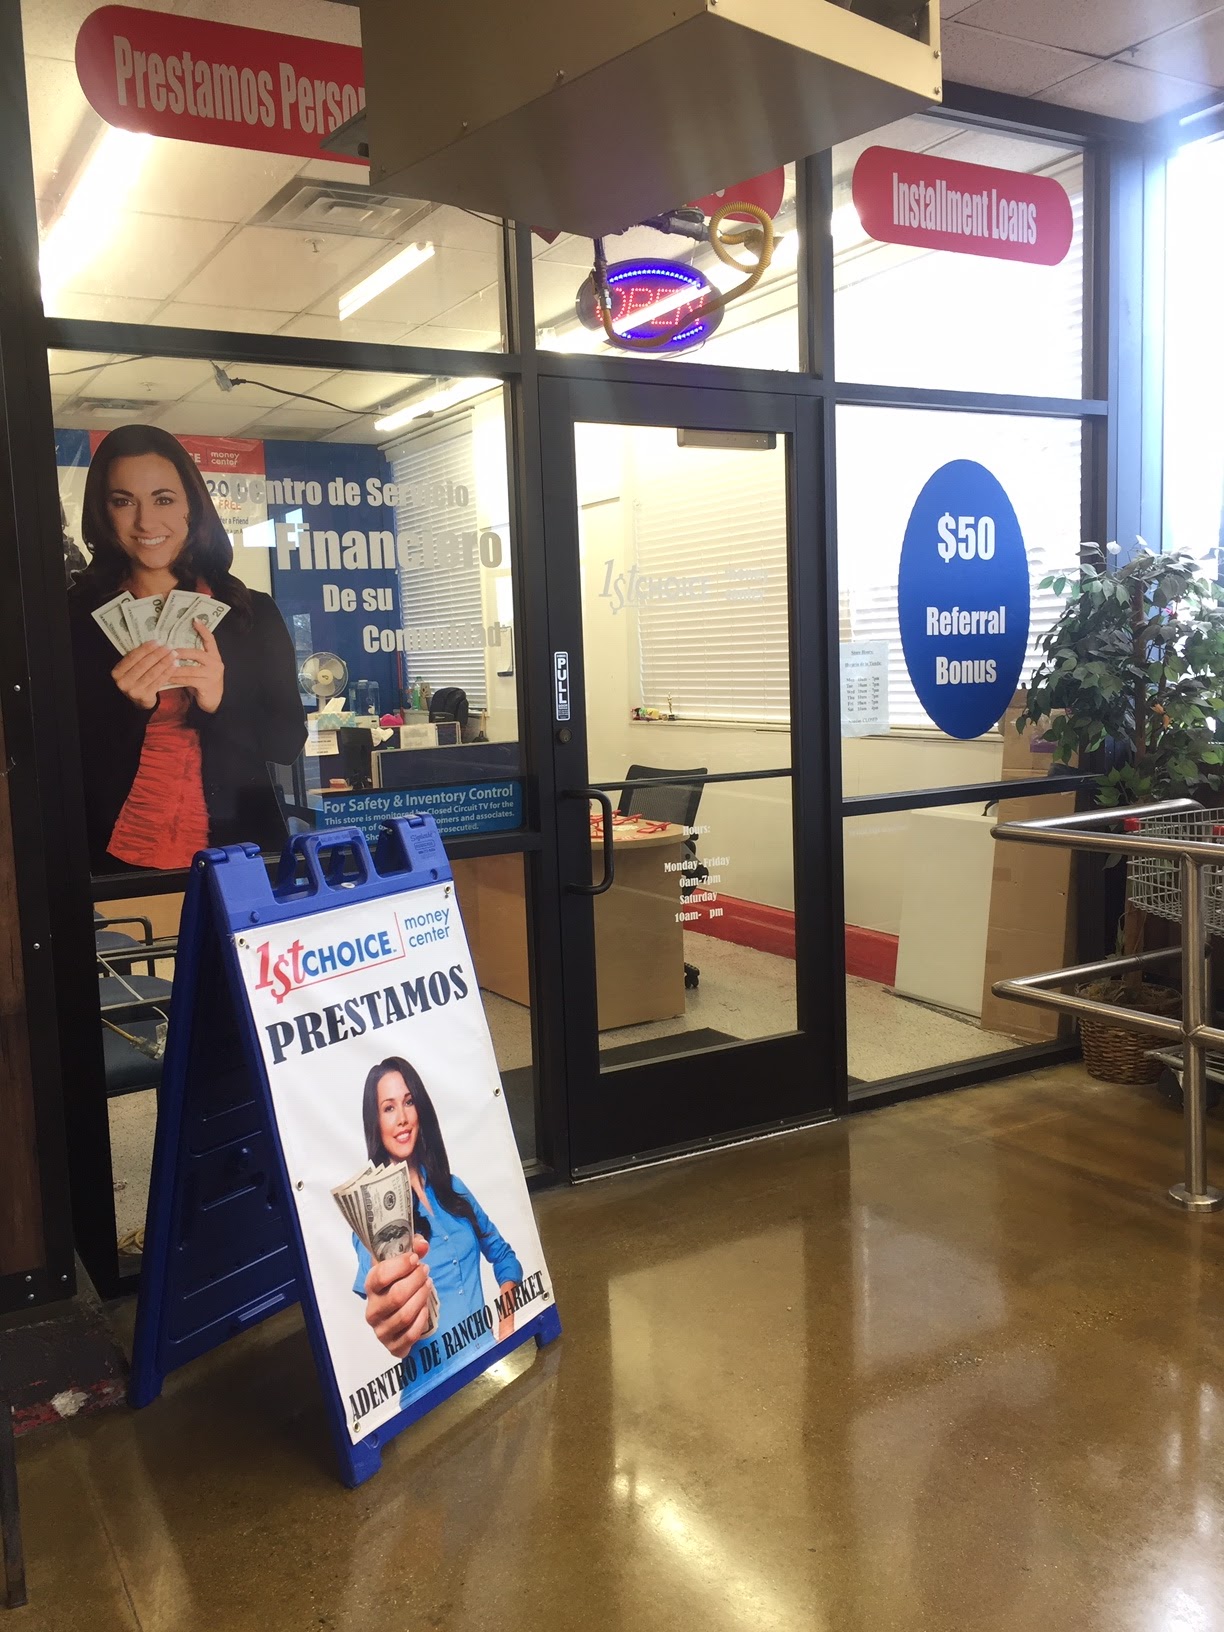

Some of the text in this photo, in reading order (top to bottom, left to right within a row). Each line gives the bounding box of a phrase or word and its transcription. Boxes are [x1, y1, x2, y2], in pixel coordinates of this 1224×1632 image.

[113, 35, 366, 134] Prestamos Perso
[893, 172, 1036, 245] Installment Loans
[211, 450, 240, 460] money
[230, 476, 323, 506] Centro
[327, 477, 361, 507] de
[275, 522, 503, 570] Financiero
[937, 512, 996, 564] $50
[322, 584, 394, 612] De su
[926, 606, 1006, 636] Referral
[557, 657, 567, 704] PULL
[936, 656, 997, 685] Bonus
[324, 784, 513, 814] For Safety & Inventory Control
[325, 816, 342, 826] This
[343, 815, 364, 824] store
[373, 809, 415, 821] monitored
[427, 805, 452, 815] Closed
[453, 804, 477, 813] Circuit
[478, 802, 488, 810] TV
[489, 801, 500, 809] for
[501, 800, 514, 808] the
[368, 823, 377, 831] of
[460, 813, 475, 822] and
[476, 810, 515, 820] associates.
[682, 824, 711, 836] Hours:
[680, 891, 718, 905] Saturday
[404, 907, 450, 930] money
[408, 925, 450, 948] center
[265, 963, 469, 1065] PRESTAMOS
[348, 1270, 545, 1422] ADENTRO DE RANCHO MARKET
